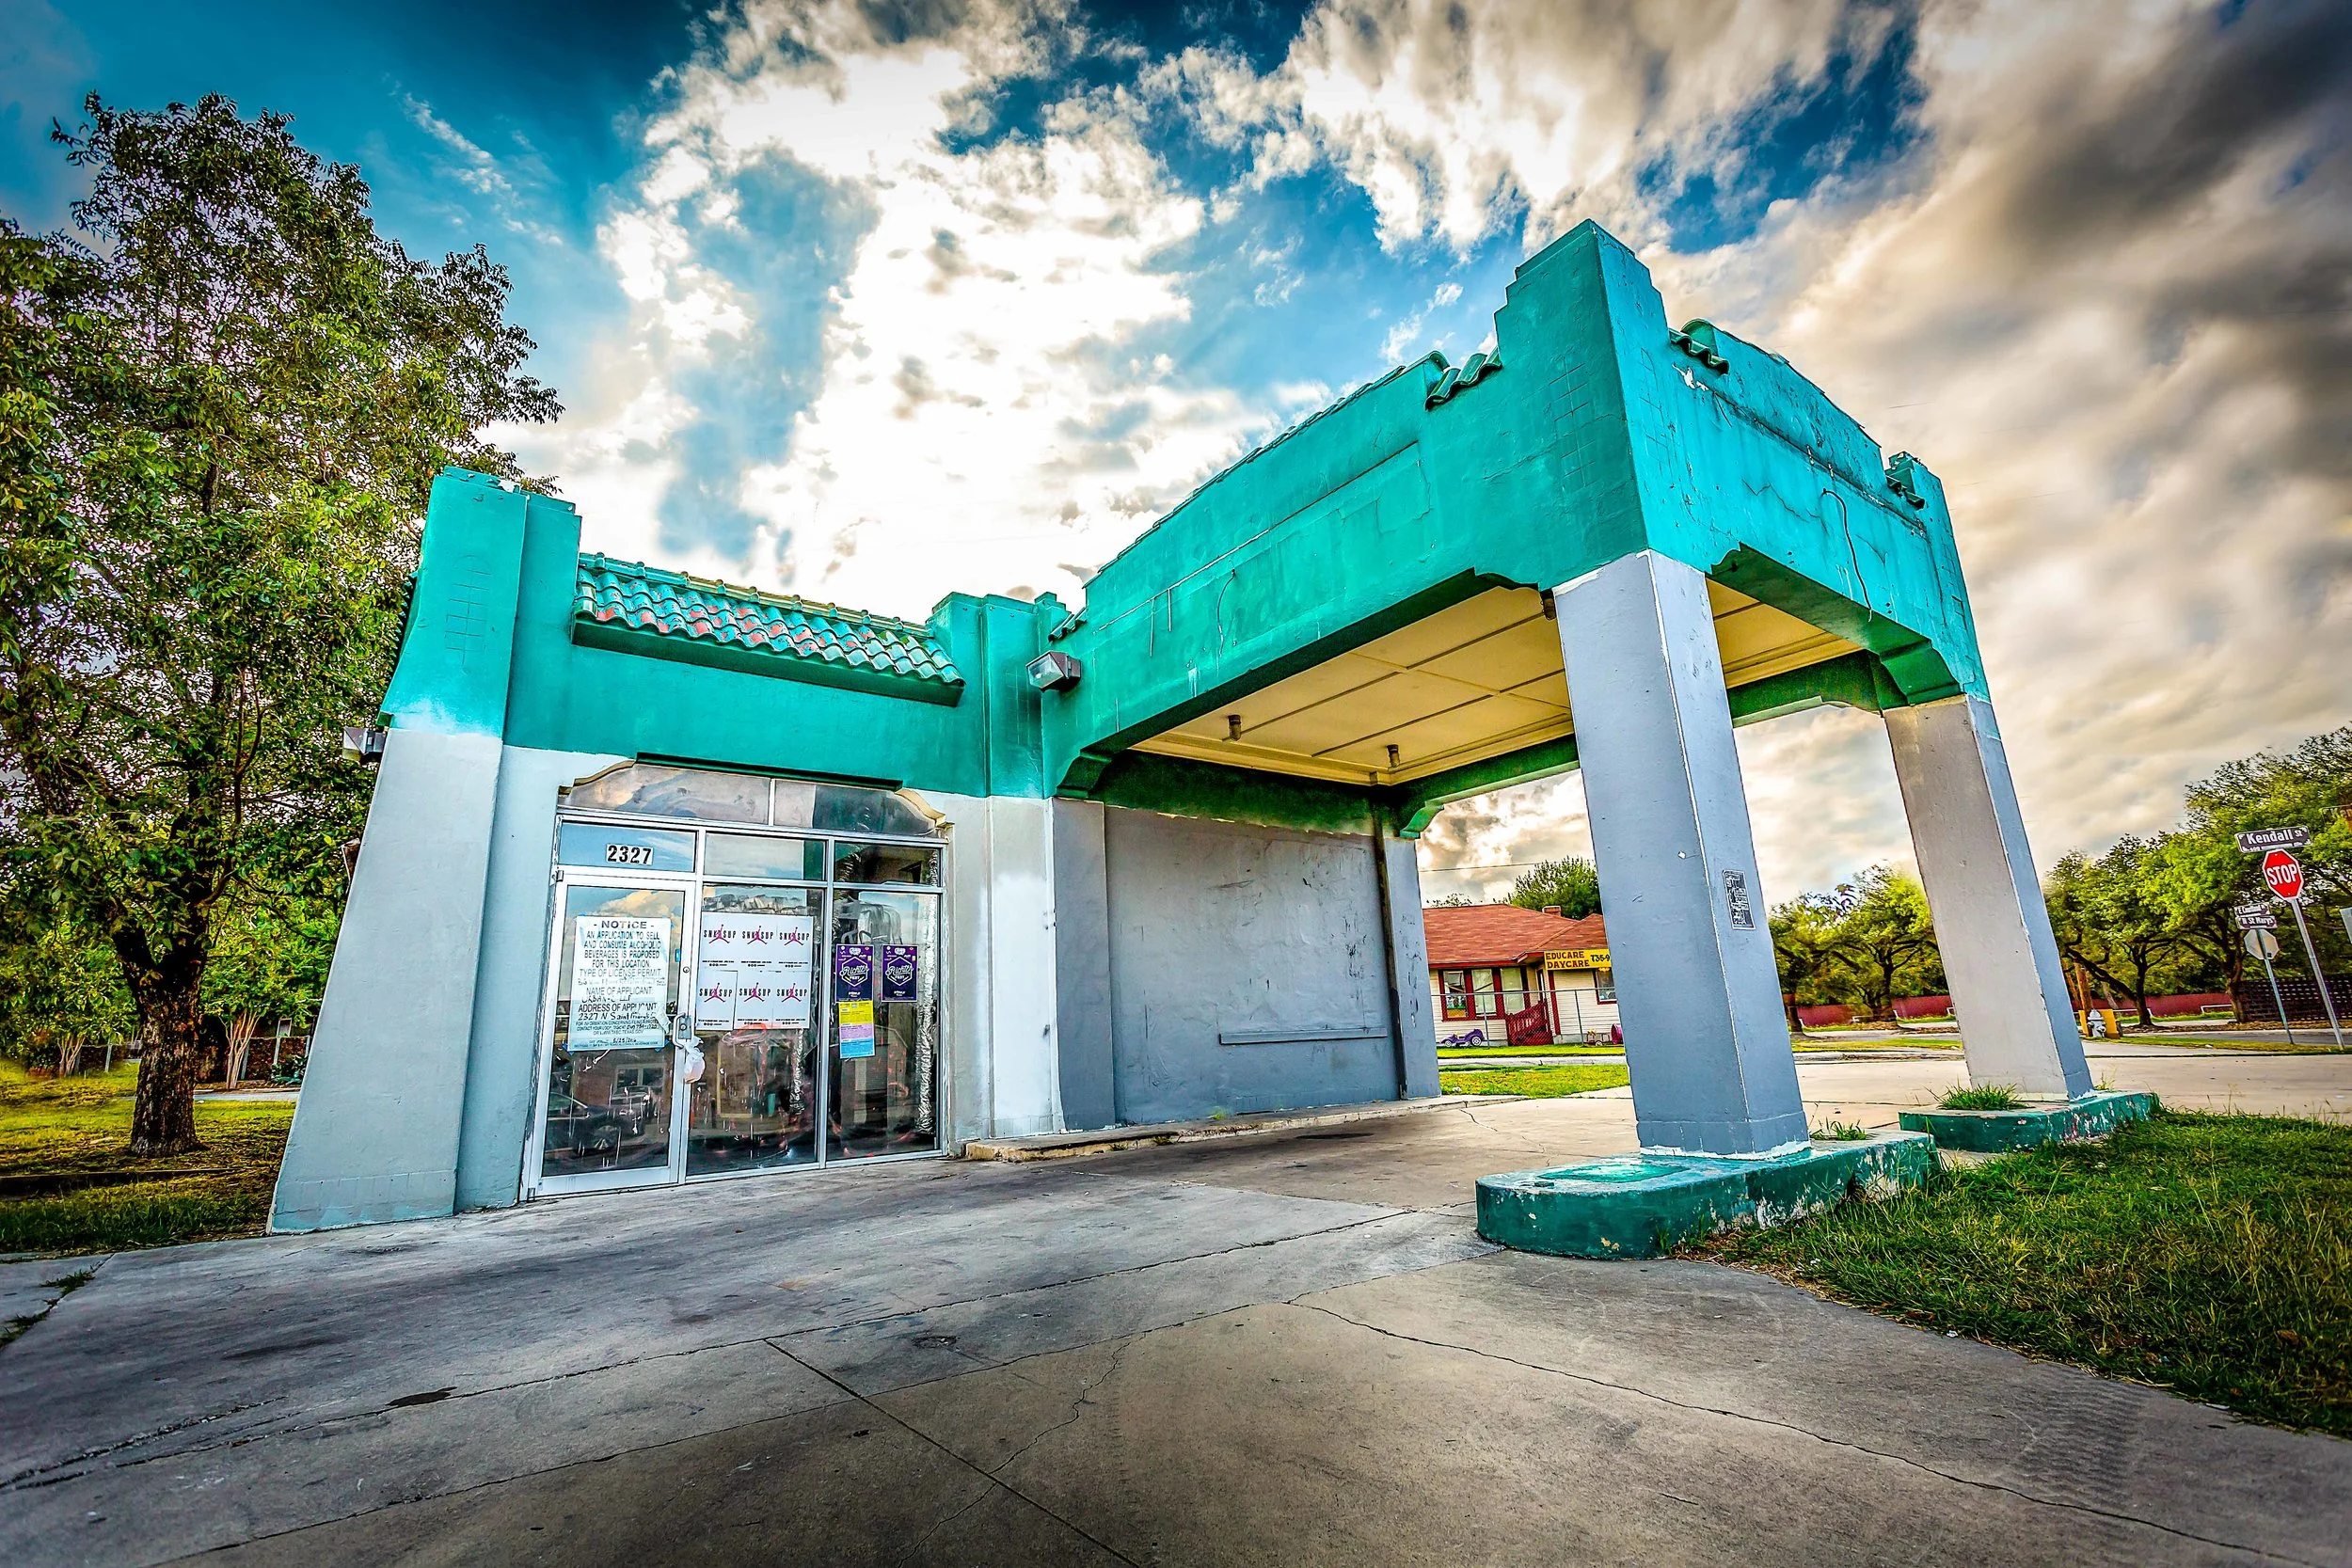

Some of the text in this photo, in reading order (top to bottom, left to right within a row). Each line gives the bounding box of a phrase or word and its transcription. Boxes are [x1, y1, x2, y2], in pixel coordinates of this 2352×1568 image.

[2246, 829, 2294, 844] Kendall
[607, 845, 652, 864] 2327
[2266, 863, 2297, 886] STOP
[601, 920, 647, 929] NOTICE
[597, 931, 633, 940] APPLICATION
[636, 931, 643, 940] TO
[646, 931, 660, 940] SELL
[599, 941, 627, 949] CONSUME
[585, 950, 618, 958] BEVERAGES
[629, 950, 660, 958] PROPOSED
[1545, 951, 1585, 960] EDUCARE
[1547, 960, 1590, 968] DAYCARE
[608, 969, 636, 977] LICENSE
[587, 987, 605, 995] NAME
[607, 987, 616, 995] OF
[578, 1004, 610, 1012] ADDRESS
[612, 1003, 621, 1011] OF
